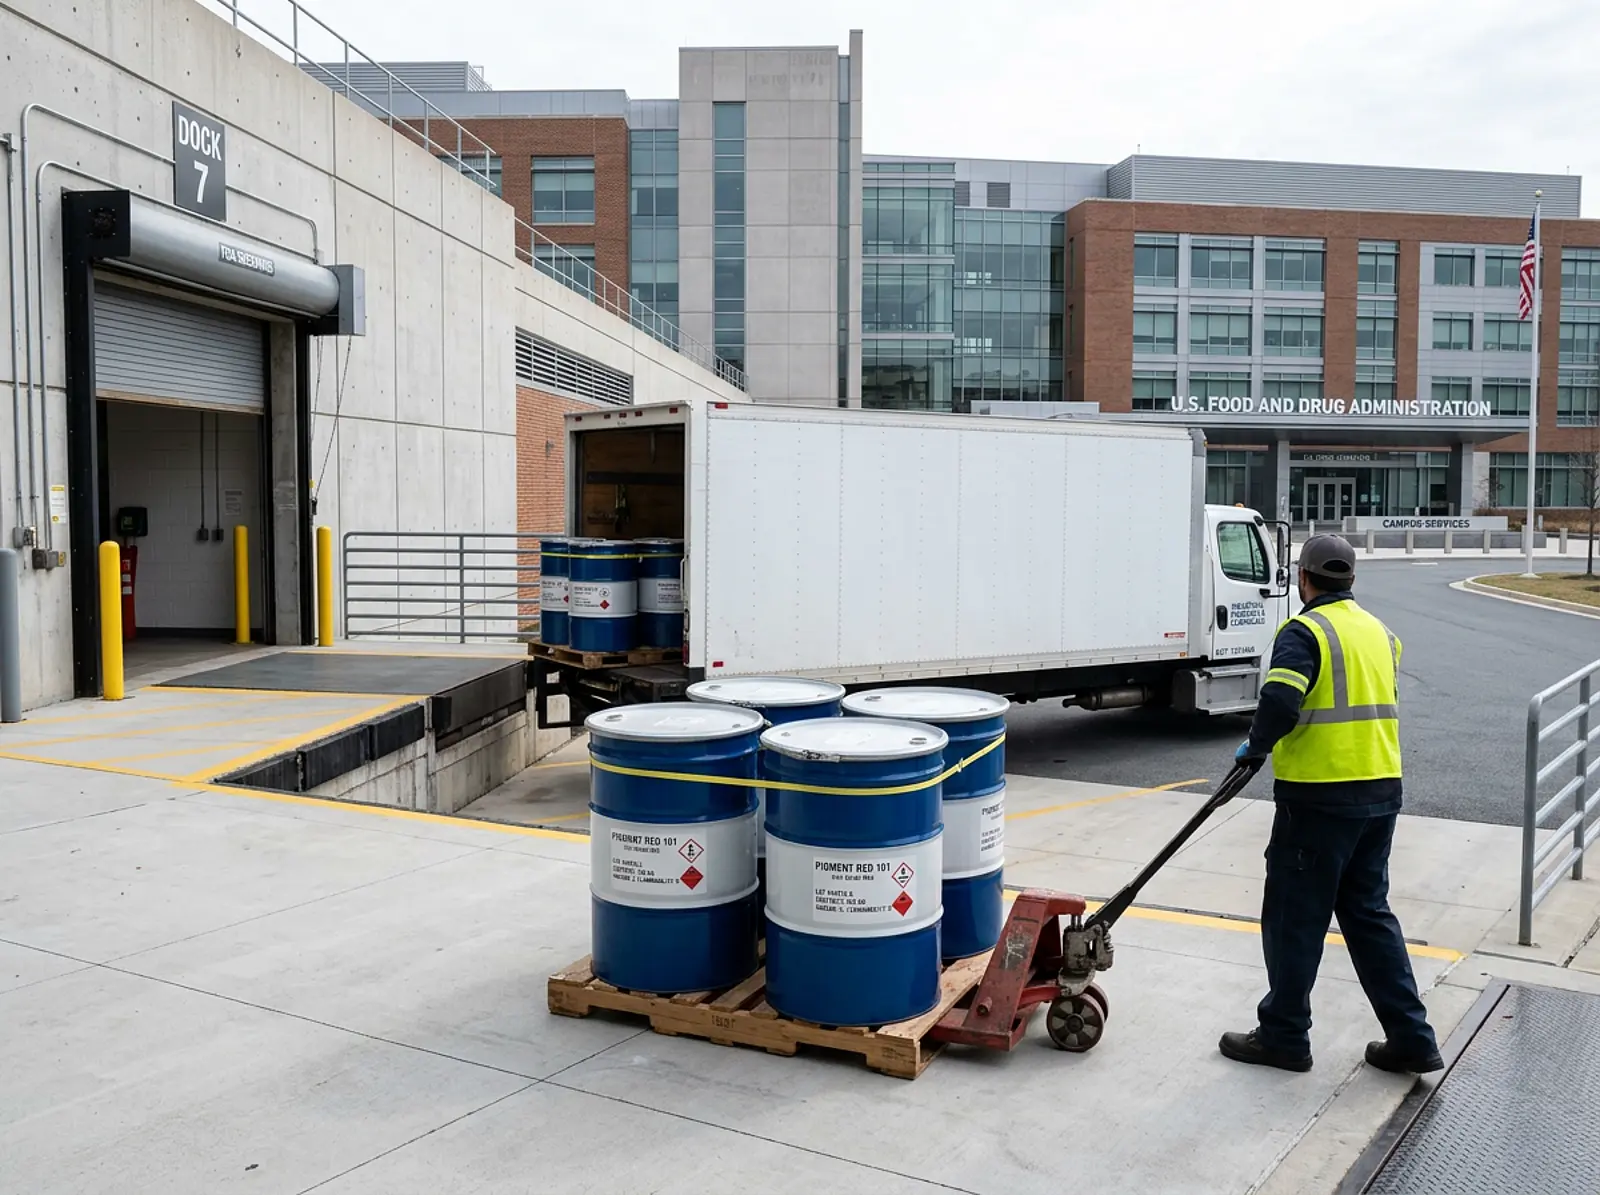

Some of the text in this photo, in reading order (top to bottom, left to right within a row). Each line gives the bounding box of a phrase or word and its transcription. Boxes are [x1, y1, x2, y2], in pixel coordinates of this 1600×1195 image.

[178, 114, 222, 161] DOCK
[194, 160, 209, 204] 7
[1171, 396, 1491, 416] U.S. FOOD AND DRUG ADMINISTRATION
[664, 837, 677, 846] 101
[856, 863, 874, 873] RED
[876, 862, 890, 872] 101
